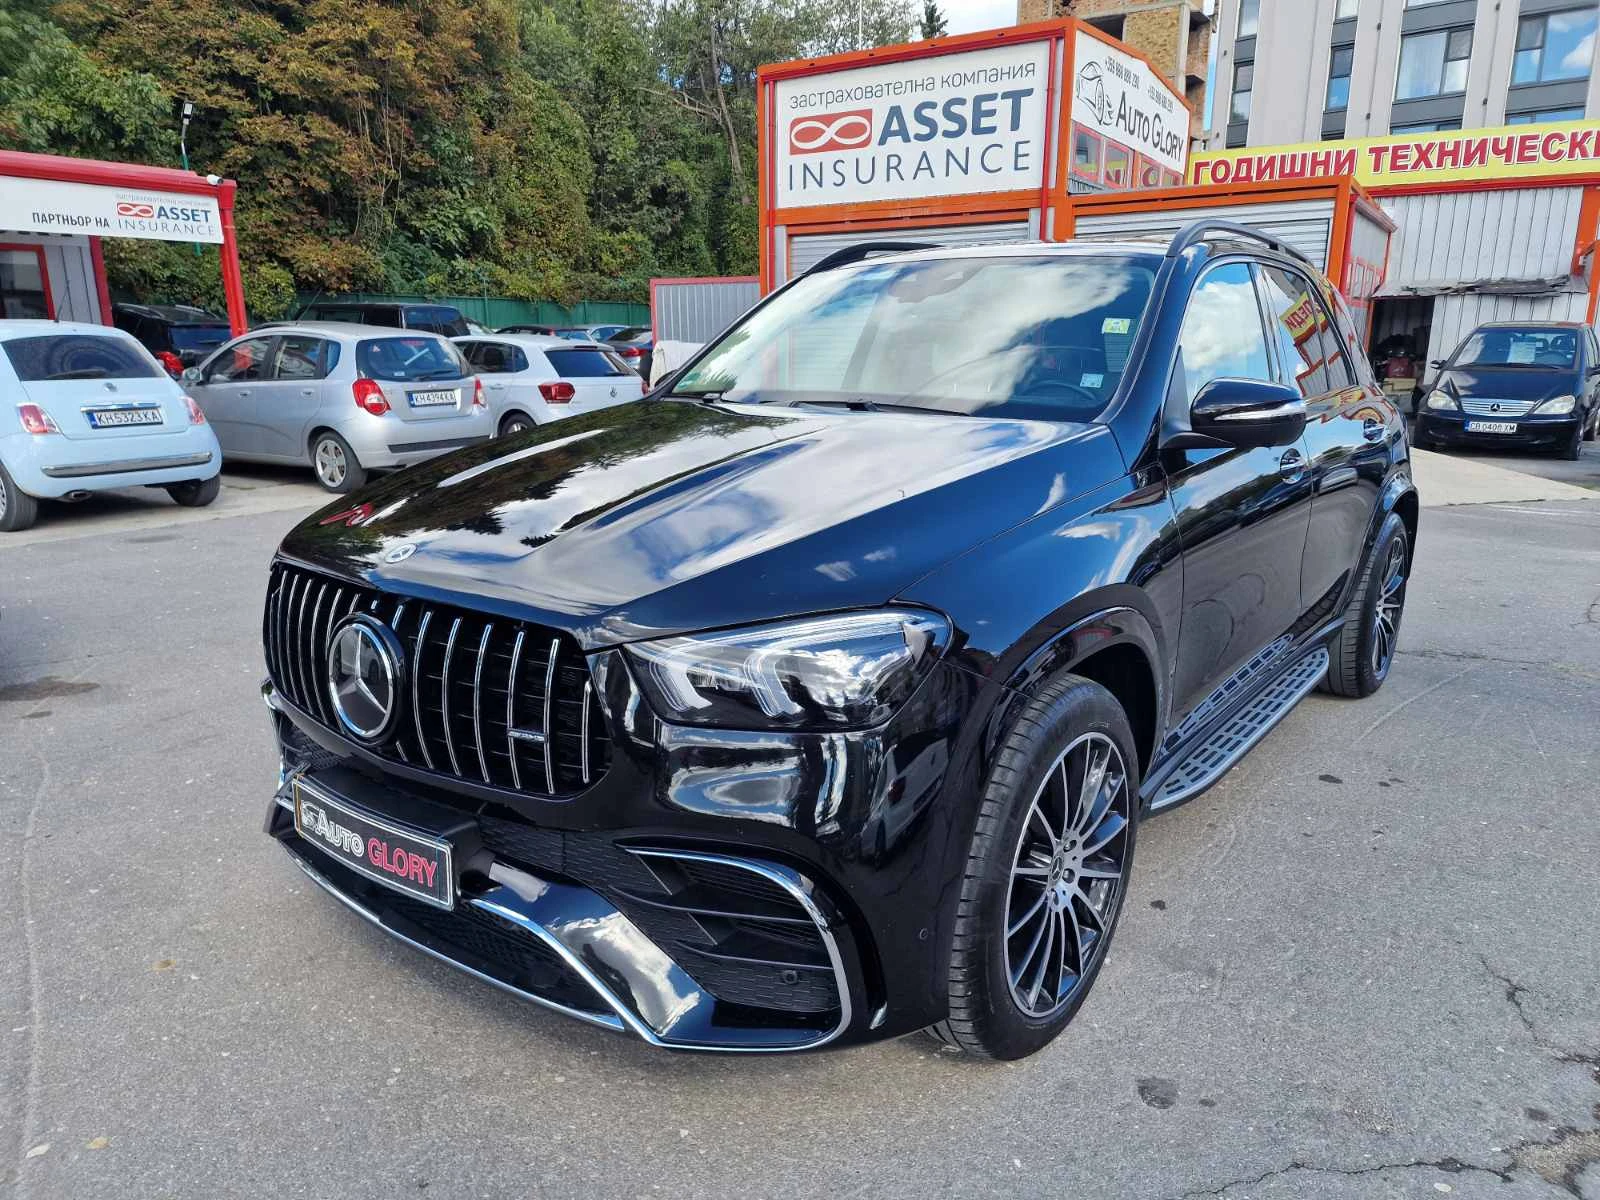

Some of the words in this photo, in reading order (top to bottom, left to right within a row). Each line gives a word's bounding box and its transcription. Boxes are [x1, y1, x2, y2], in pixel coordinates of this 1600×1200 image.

[790, 76, 936, 109] застрахователна
[941, 61, 1036, 89] компания
[877, 88, 1034, 146] ASSET
[788, 140, 1032, 191] INSURANCE
[1192, 147, 1358, 185] ГОДИШНИ
[32, 212, 92, 228] ПАРТНЬОР
[95, 216, 110, 228] НА
[117, 219, 215, 237] INSURANCE
[156, 206, 212, 223] ASSET
[315, 809, 365, 857] AUTO
[367, 837, 438, 888] GLORY
